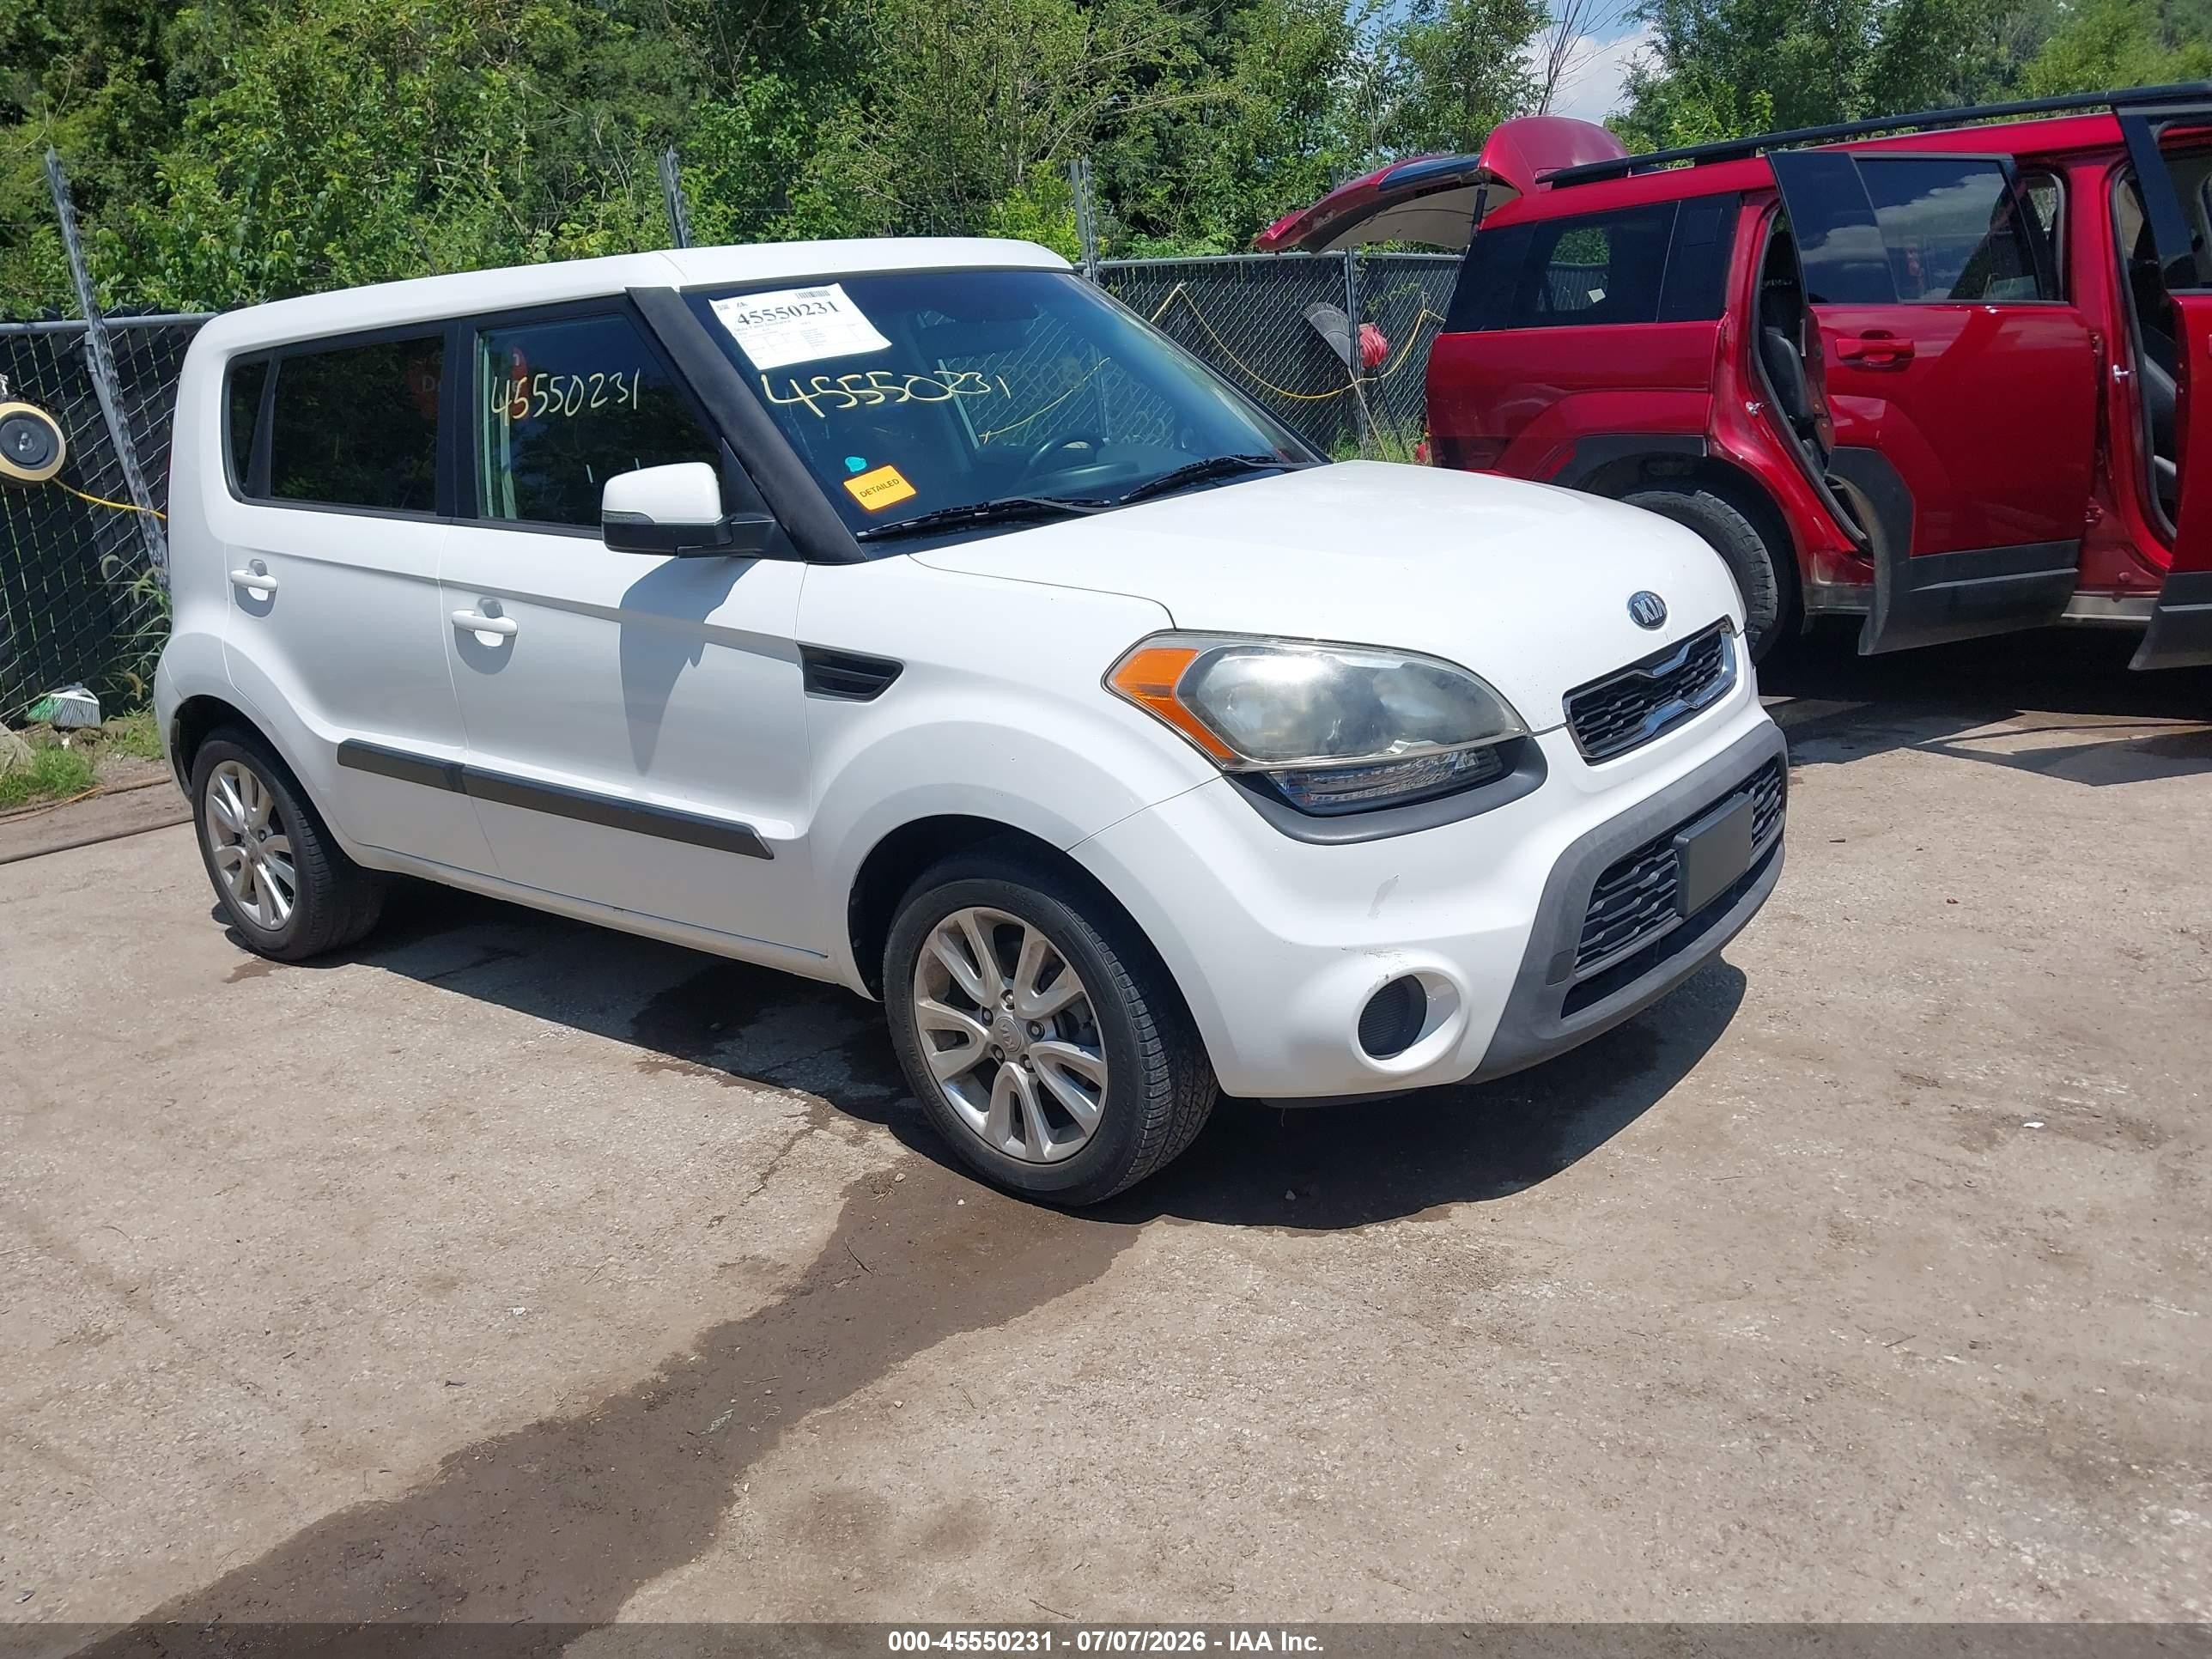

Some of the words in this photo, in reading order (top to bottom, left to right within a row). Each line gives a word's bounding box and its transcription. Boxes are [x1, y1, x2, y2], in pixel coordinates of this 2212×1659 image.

[737, 300, 841, 325] 45550231
[491, 368, 641, 426] 45550231
[760, 370, 1012, 418] 45550231
[859, 478, 900, 498] DETAILED
[1635, 596, 1665, 623] KIA
